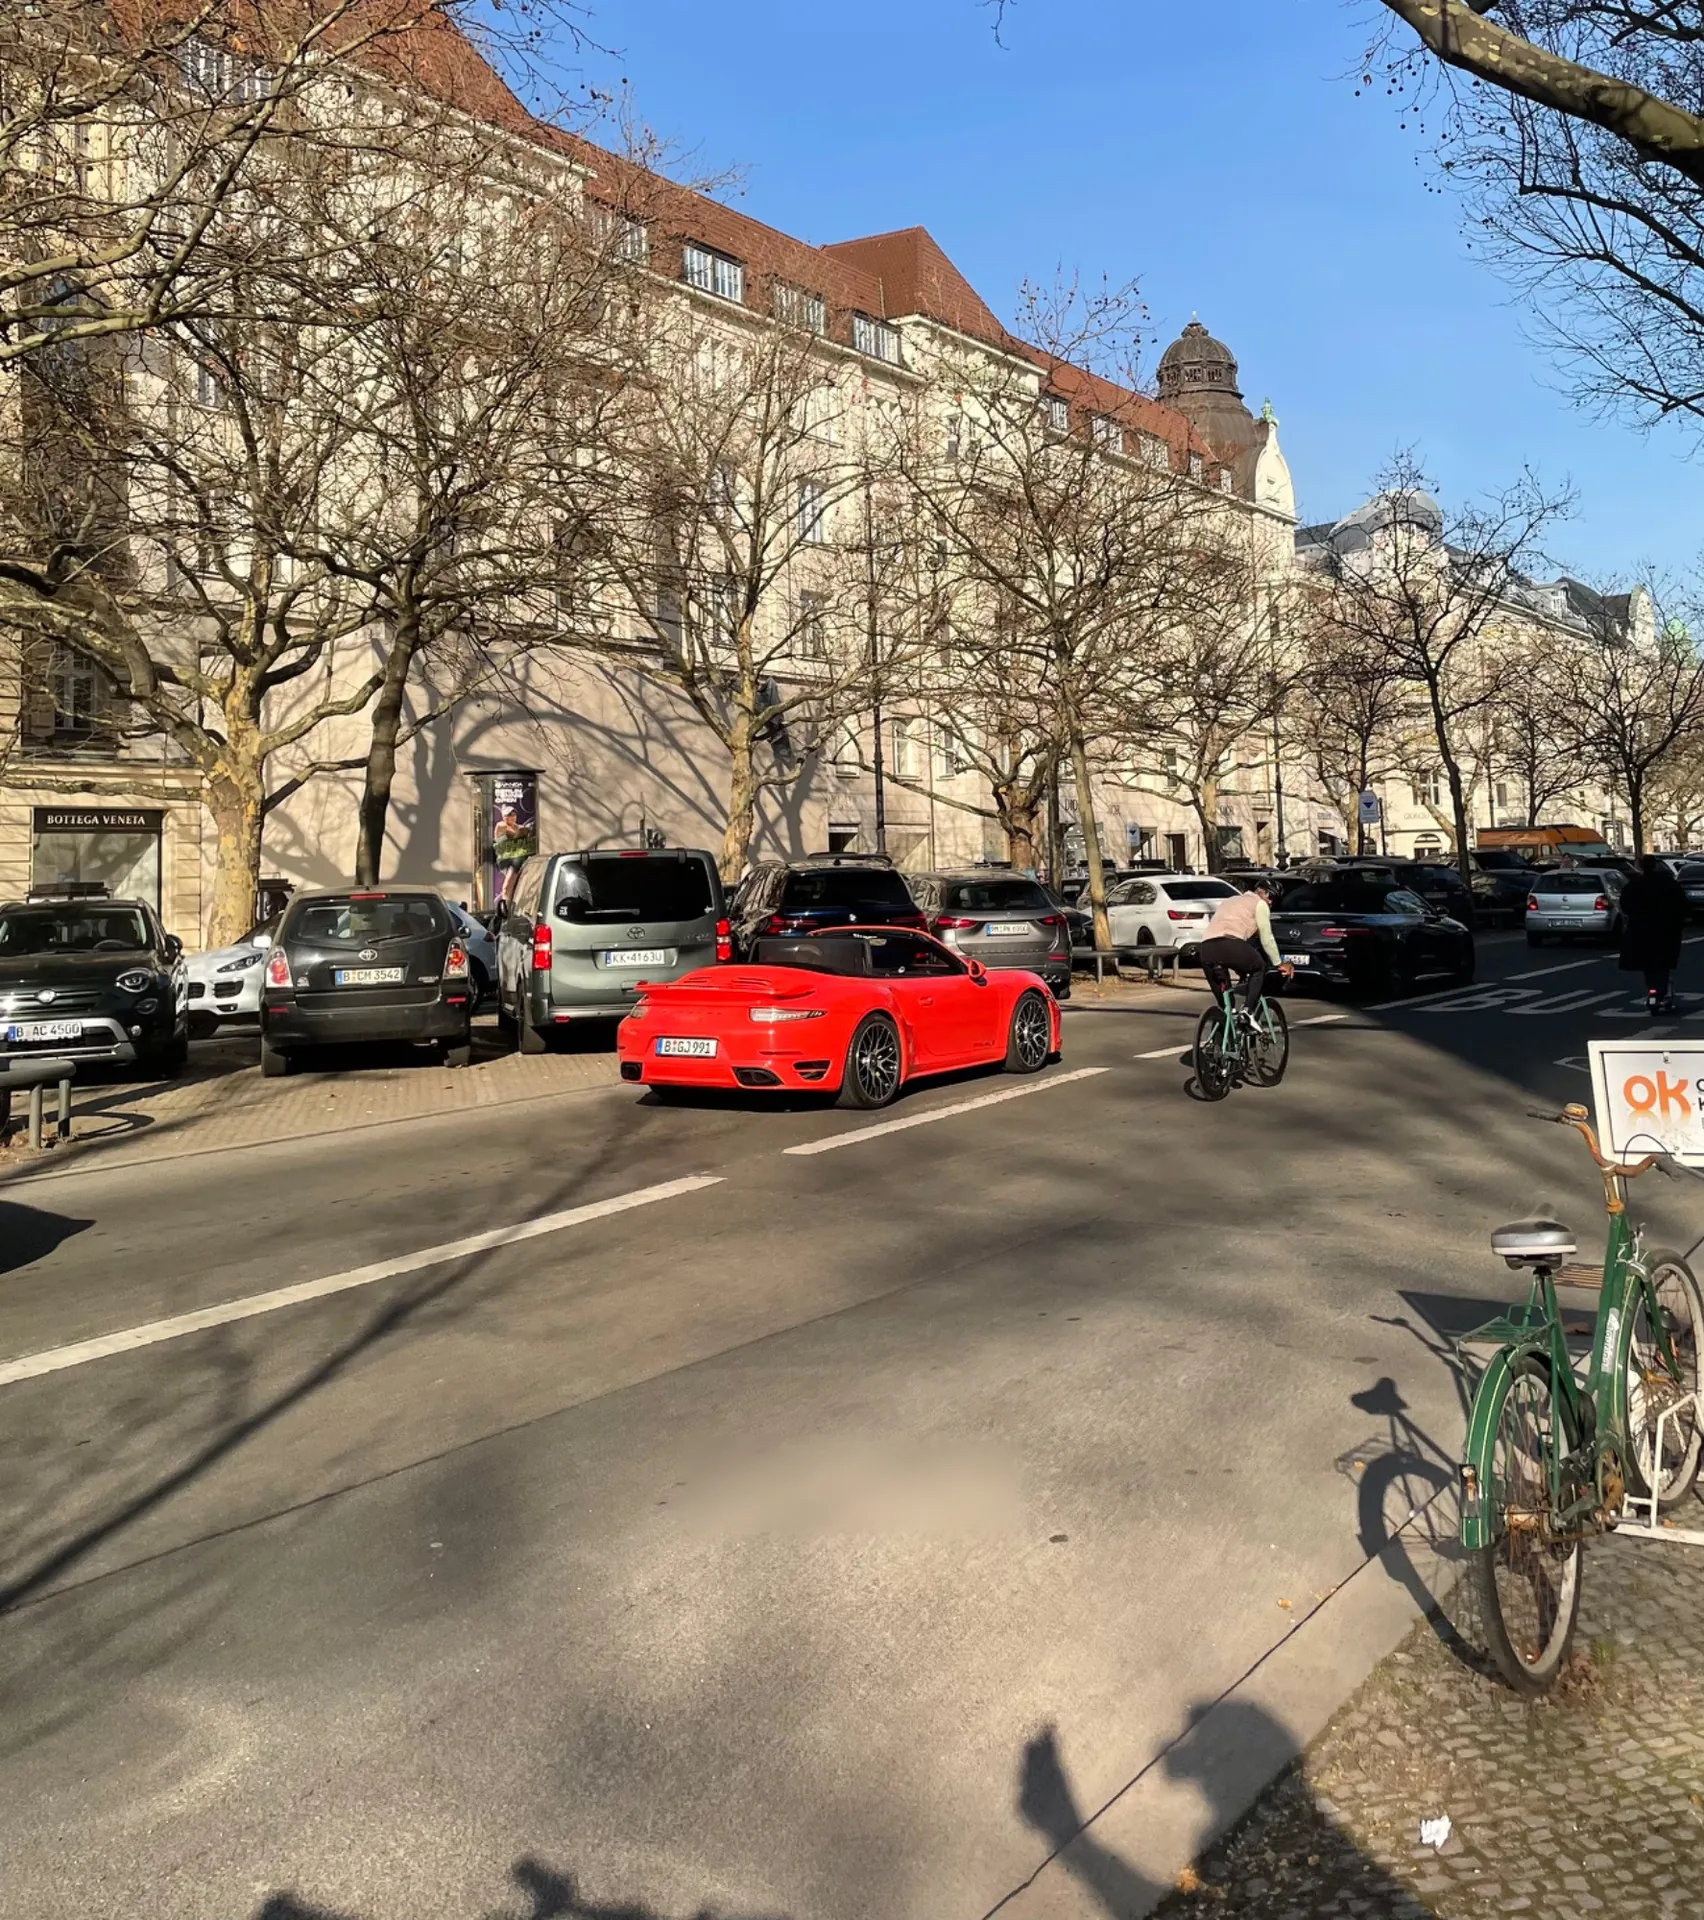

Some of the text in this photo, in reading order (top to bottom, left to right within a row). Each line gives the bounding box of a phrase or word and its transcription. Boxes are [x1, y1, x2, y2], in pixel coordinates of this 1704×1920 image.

[47, 815, 146, 825] BOTTEGA VENETA
[374, 969, 400, 980] 3542
[50, 1023, 80, 1035] 4500
